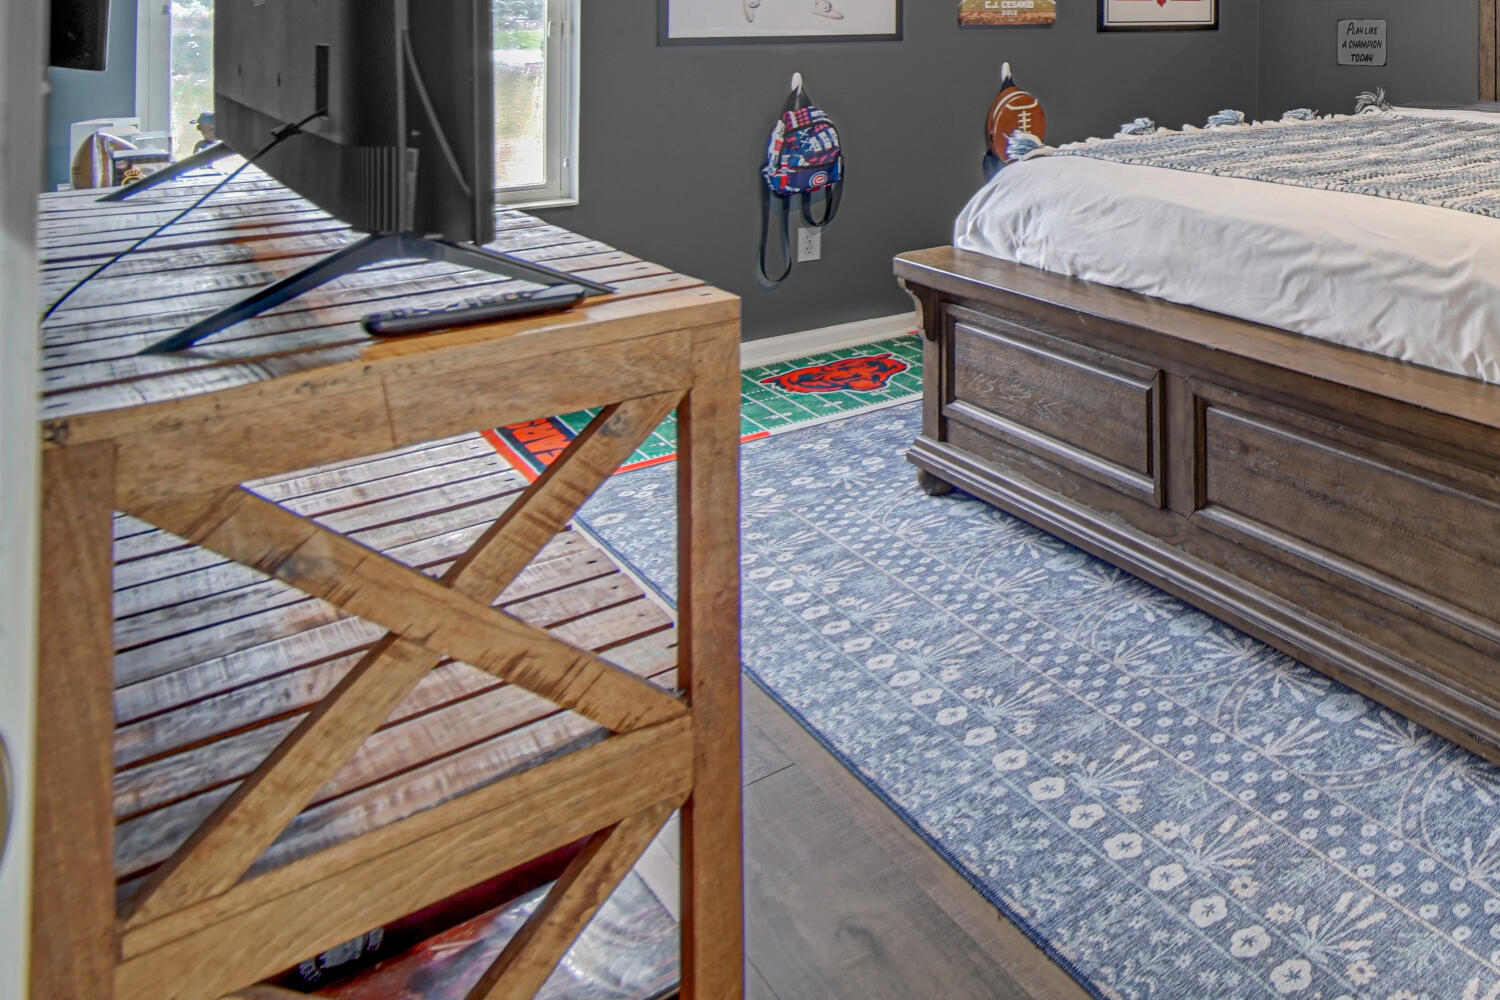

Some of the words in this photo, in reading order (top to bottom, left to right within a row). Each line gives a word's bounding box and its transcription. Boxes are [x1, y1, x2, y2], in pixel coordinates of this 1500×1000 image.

[1364, 26, 1378, 35] LIKE
[1341, 40, 1347, 49] A
[1348, 40, 1383, 49] CHAMPION
[1350, 53, 1374, 63] TODAY
